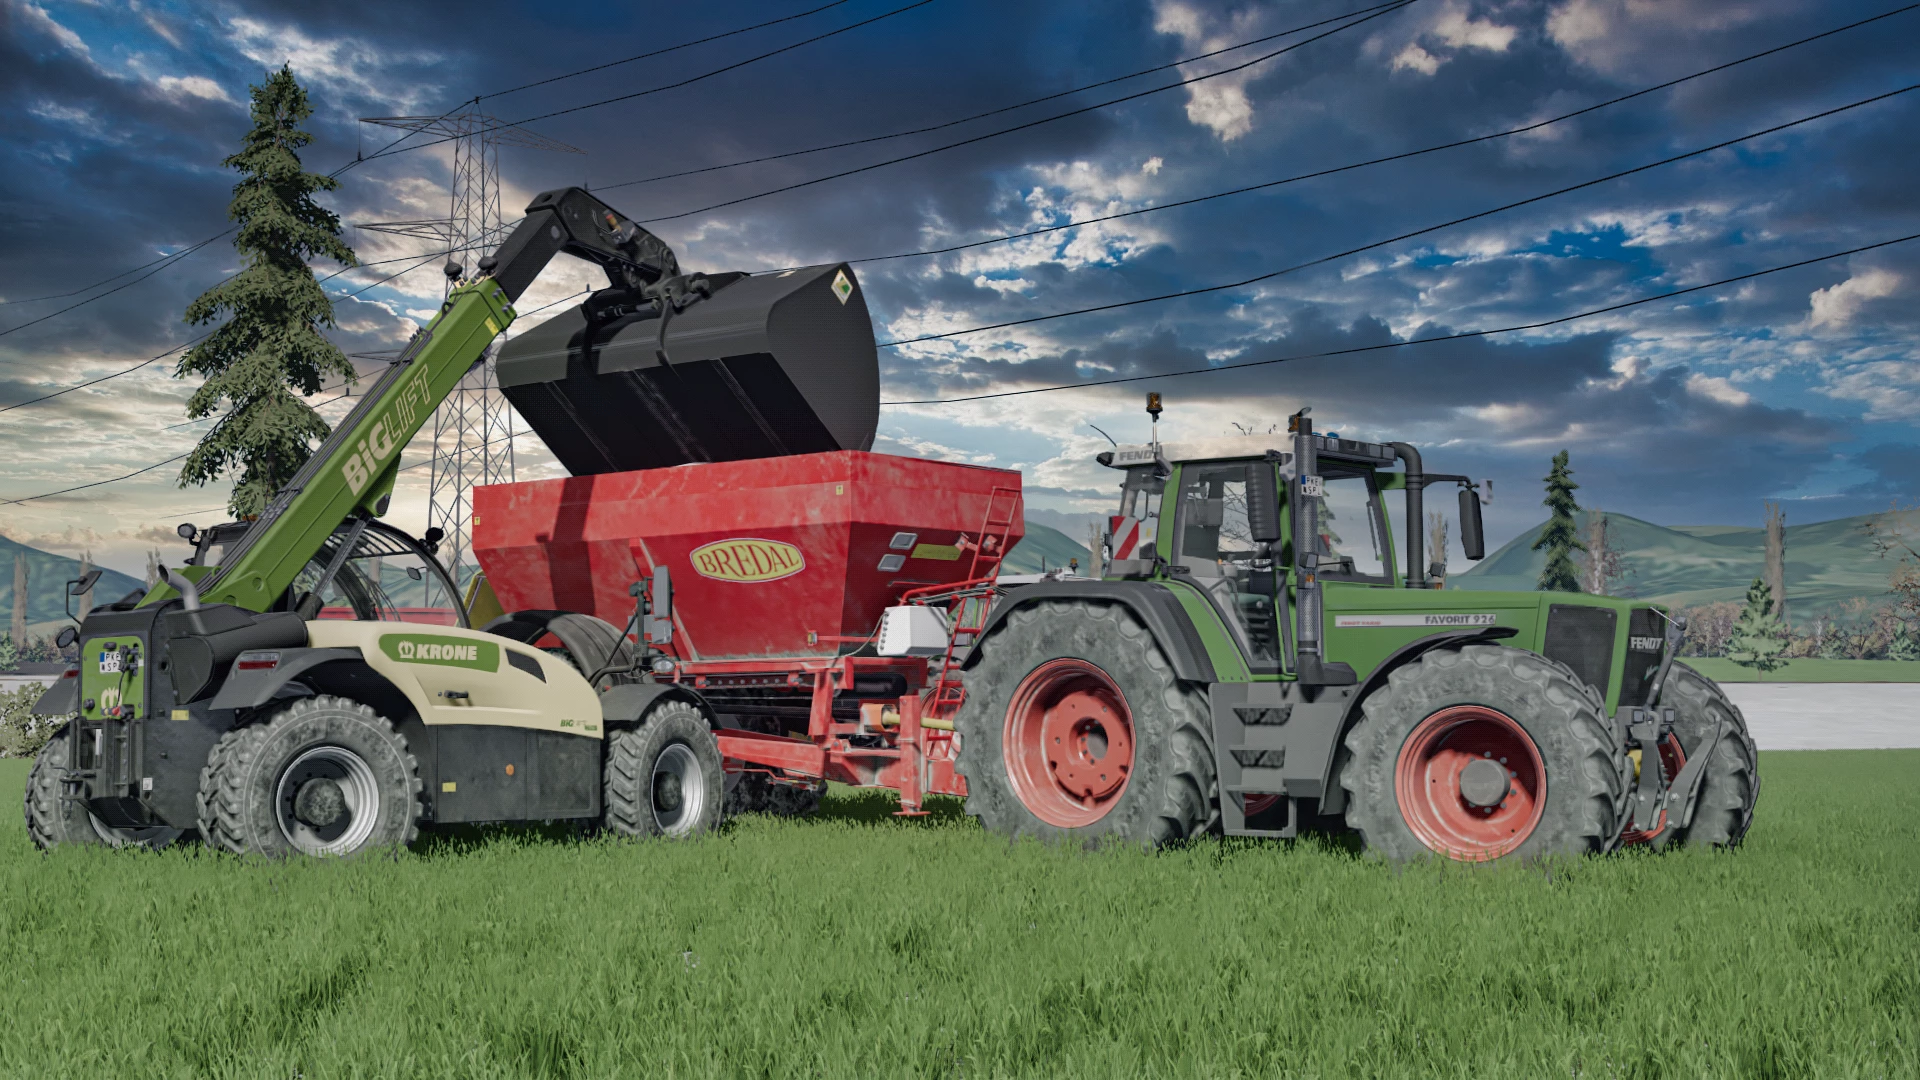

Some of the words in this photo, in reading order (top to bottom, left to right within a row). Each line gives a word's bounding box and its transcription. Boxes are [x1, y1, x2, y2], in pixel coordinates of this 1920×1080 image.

[1119, 450, 1155, 461] FEND
[699, 544, 799, 578] BREDAL
[1425, 615, 1471, 625] FAVORIT
[1473, 614, 1495, 624] 926
[1630, 636, 1664, 650] FENDT
[416, 643, 478, 661] KRONE
